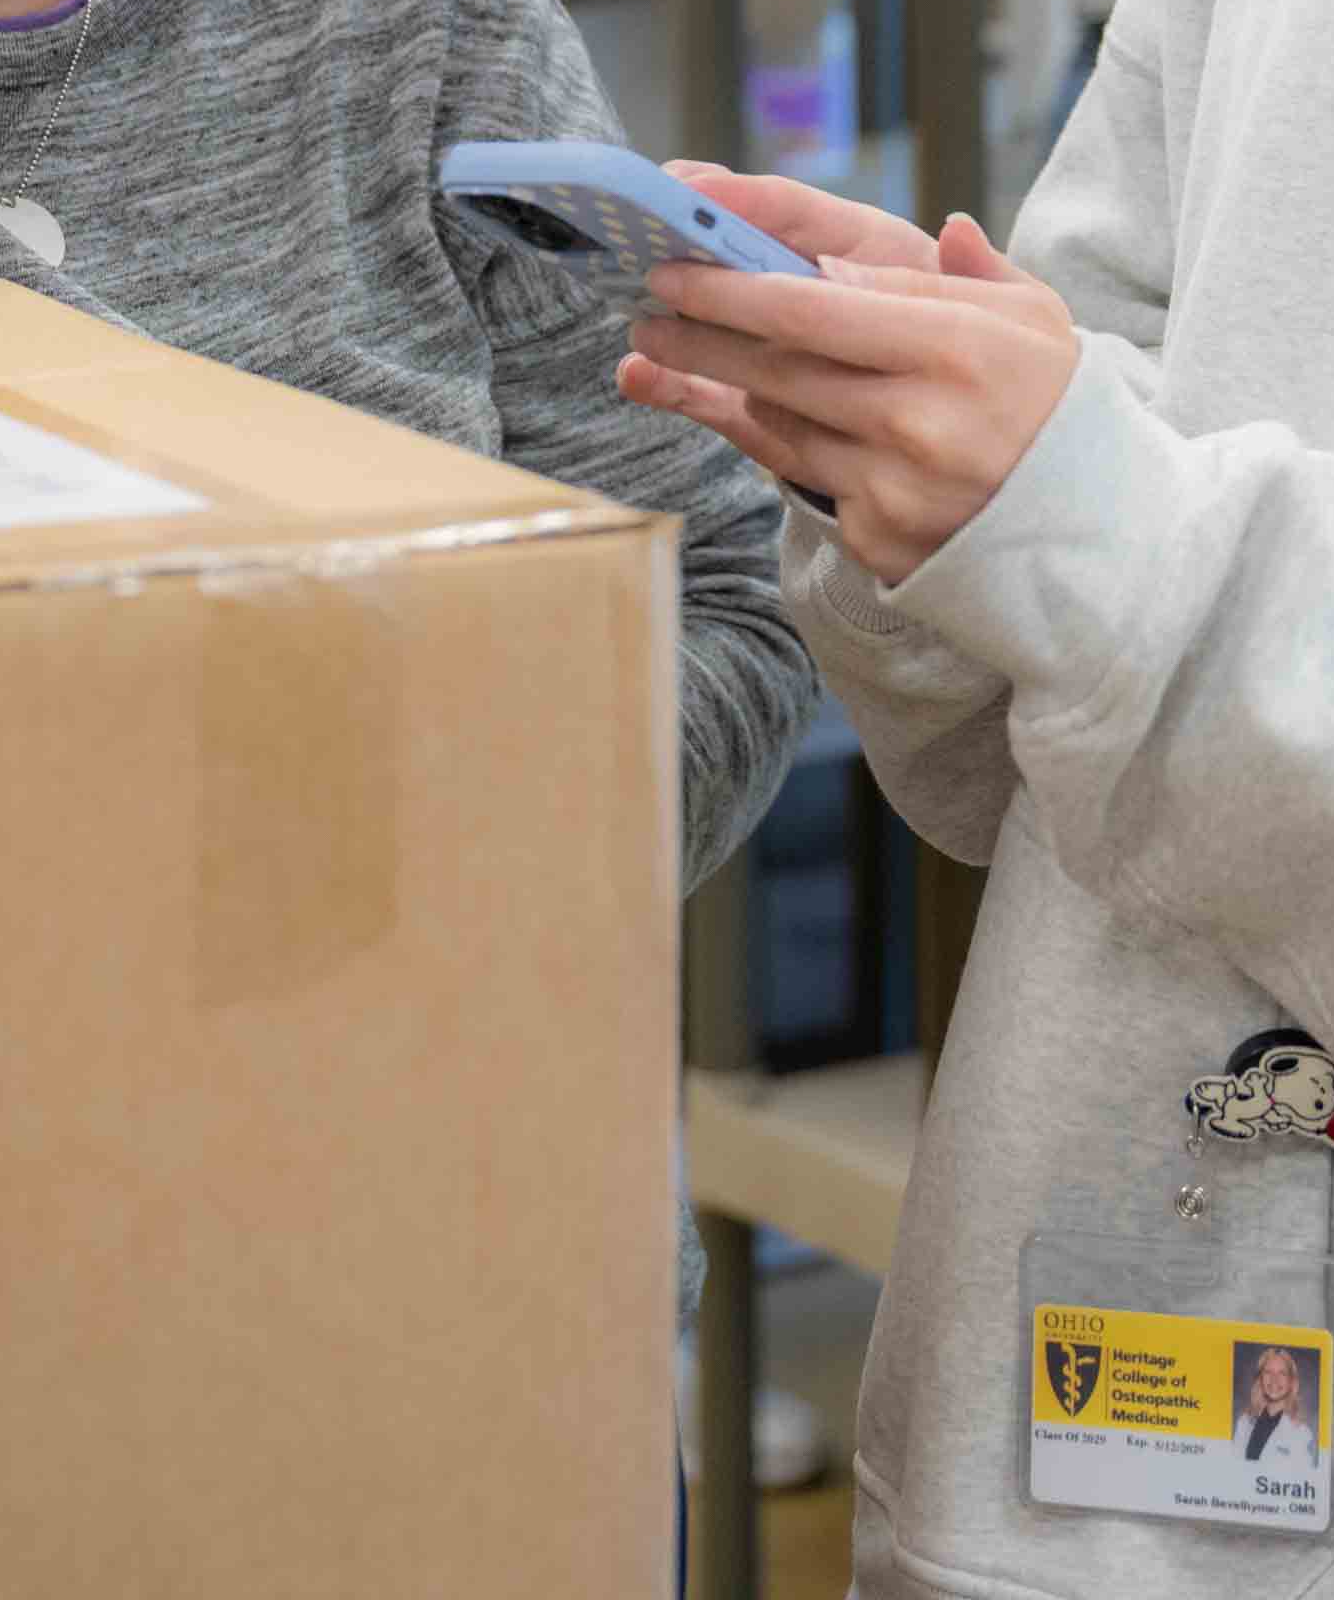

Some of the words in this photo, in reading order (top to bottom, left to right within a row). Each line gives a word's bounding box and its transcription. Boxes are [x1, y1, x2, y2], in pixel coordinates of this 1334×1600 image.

[1043, 1312, 1105, 1333] OHIO
[1113, 1348, 1177, 1368] Heritage
[1113, 1368, 1167, 1388] College
[1171, 1374, 1187, 1388] of
[1112, 1389, 1200, 1409] Osteopathic
[1112, 1408, 1179, 1426] Medicine
[1034, 1428, 1062, 1441] Class
[1065, 1431, 1081, 1443] Of
[1255, 1475, 1316, 1499] Sarah
[1173, 1492, 1208, 1505] Sarah
